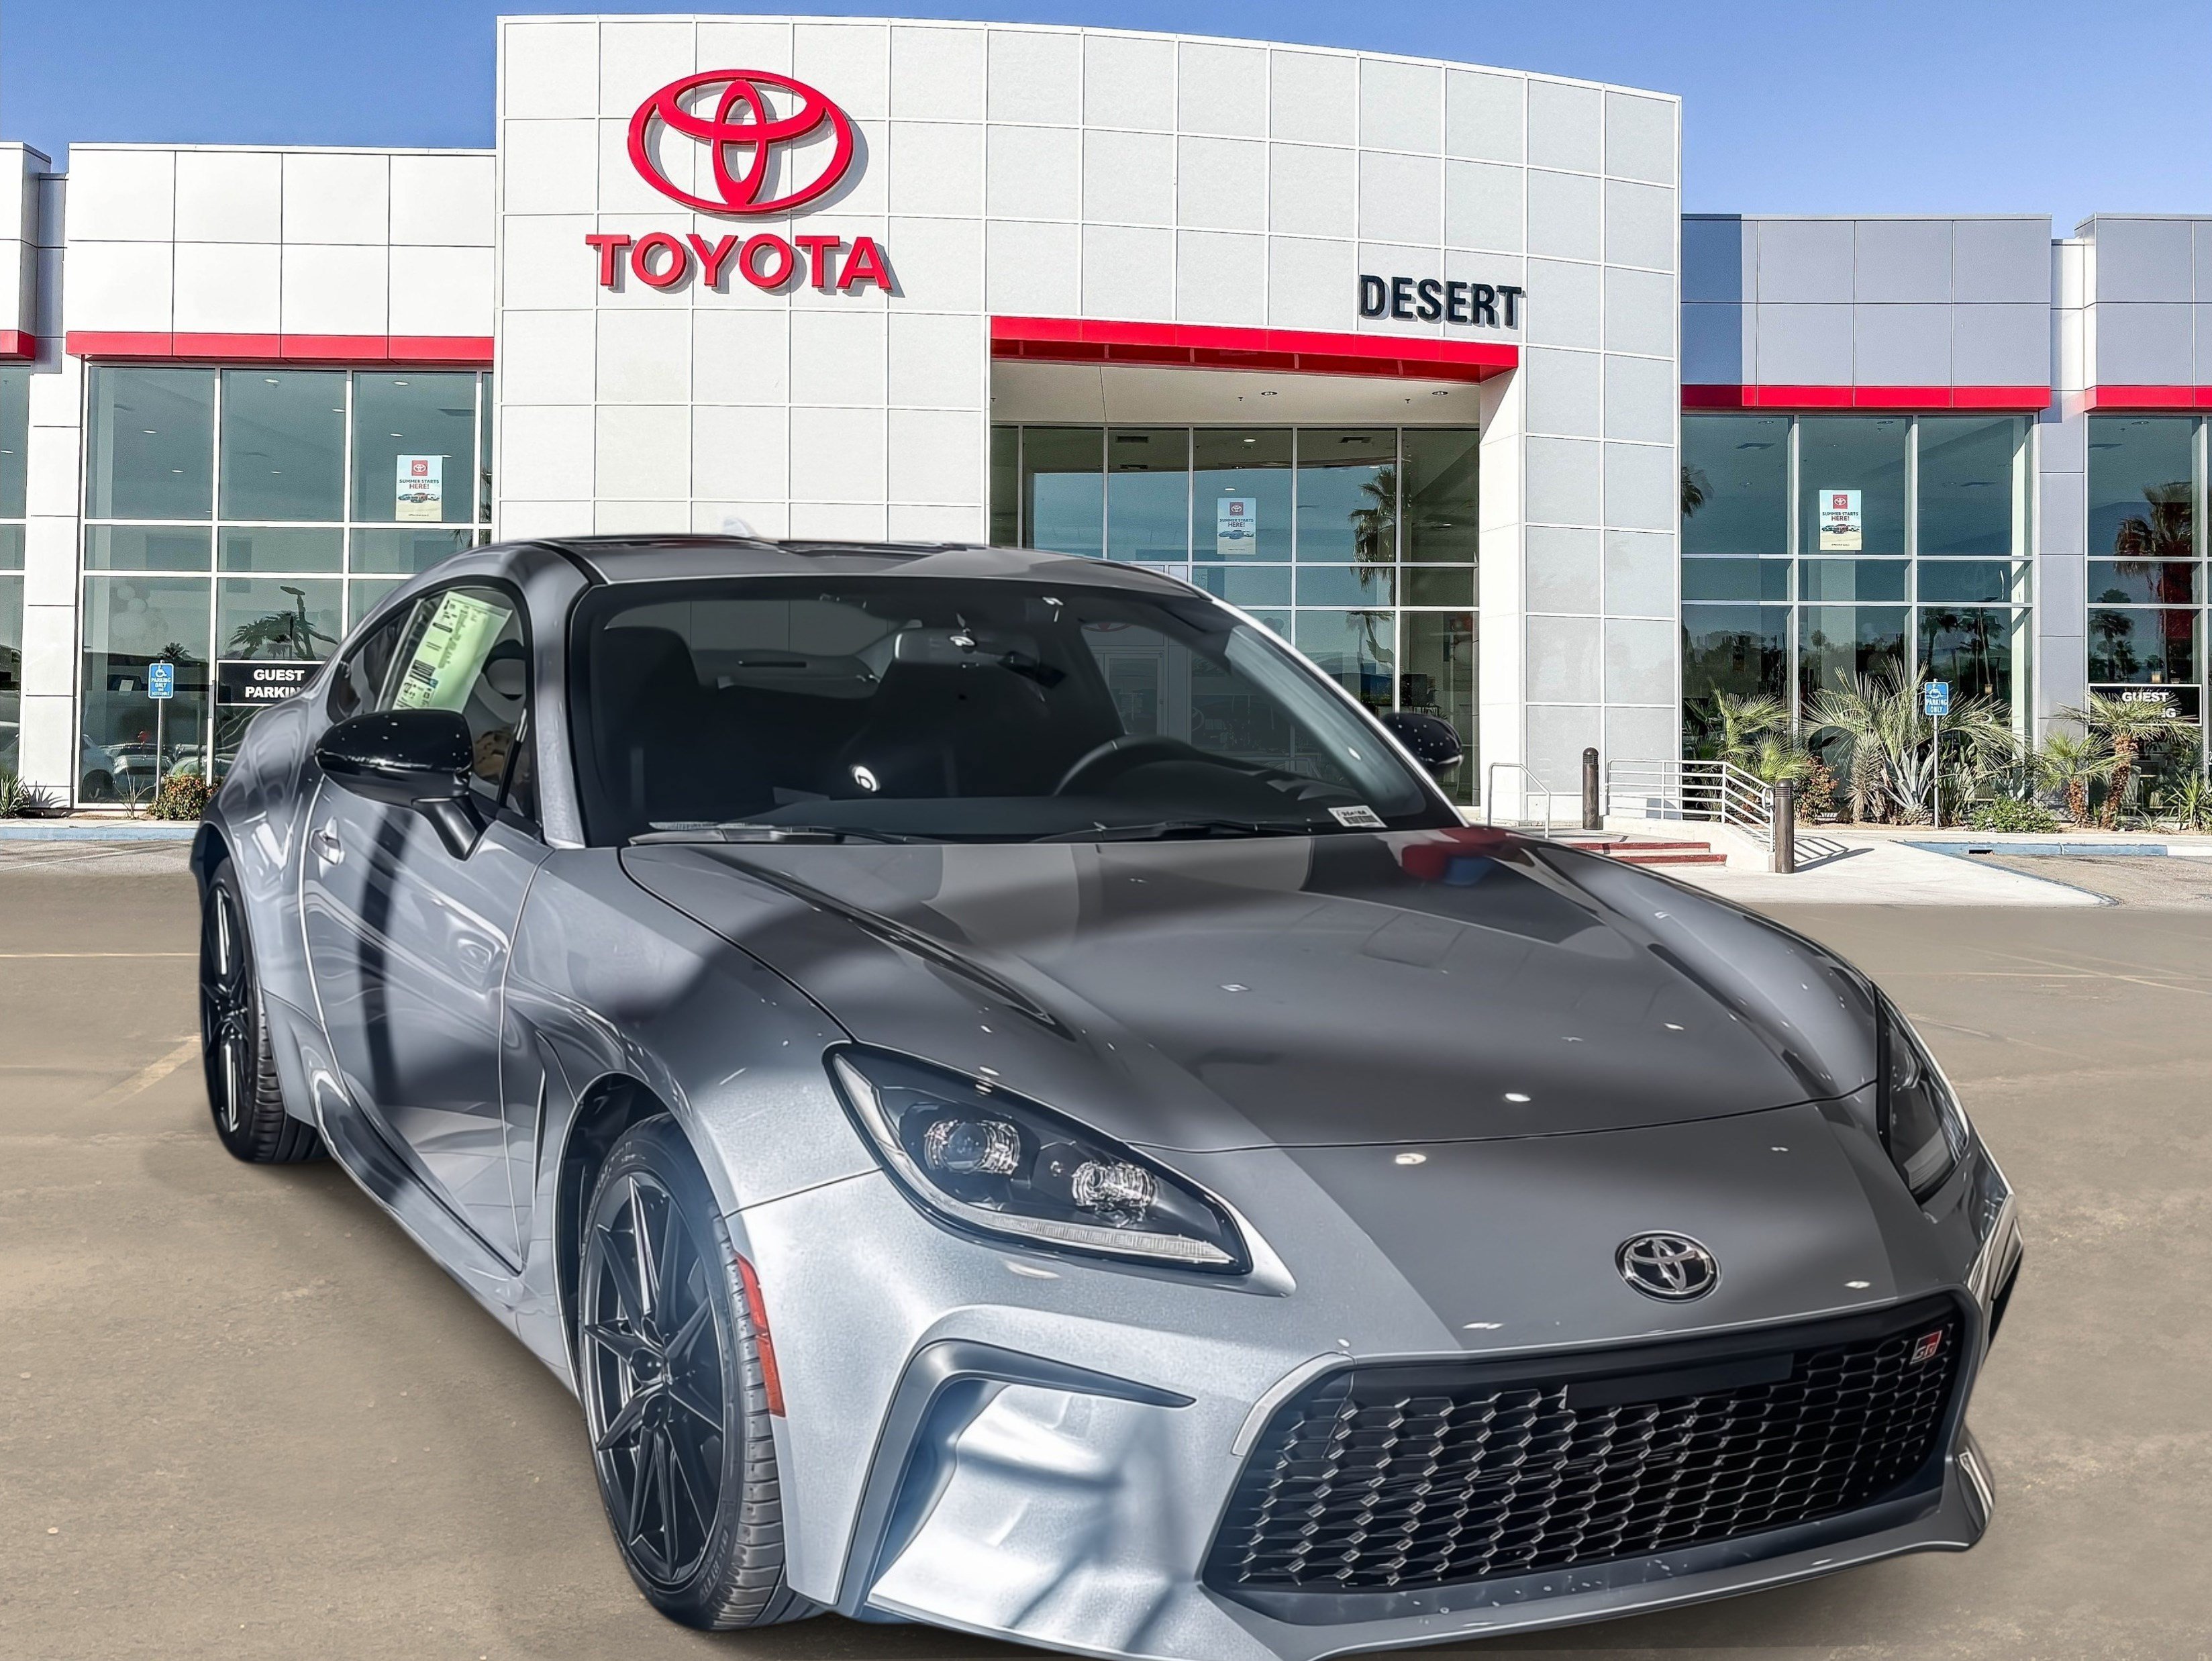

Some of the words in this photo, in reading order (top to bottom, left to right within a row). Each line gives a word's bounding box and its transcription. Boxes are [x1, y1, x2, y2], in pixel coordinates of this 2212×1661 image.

[585, 232, 893, 292] TOYOTA
[1358, 274, 1522, 326] DESERT
[253, 669, 305, 681] GUEST
[245, 686, 301, 699] PARKIN
[2121, 692, 2169, 703] GUEST
